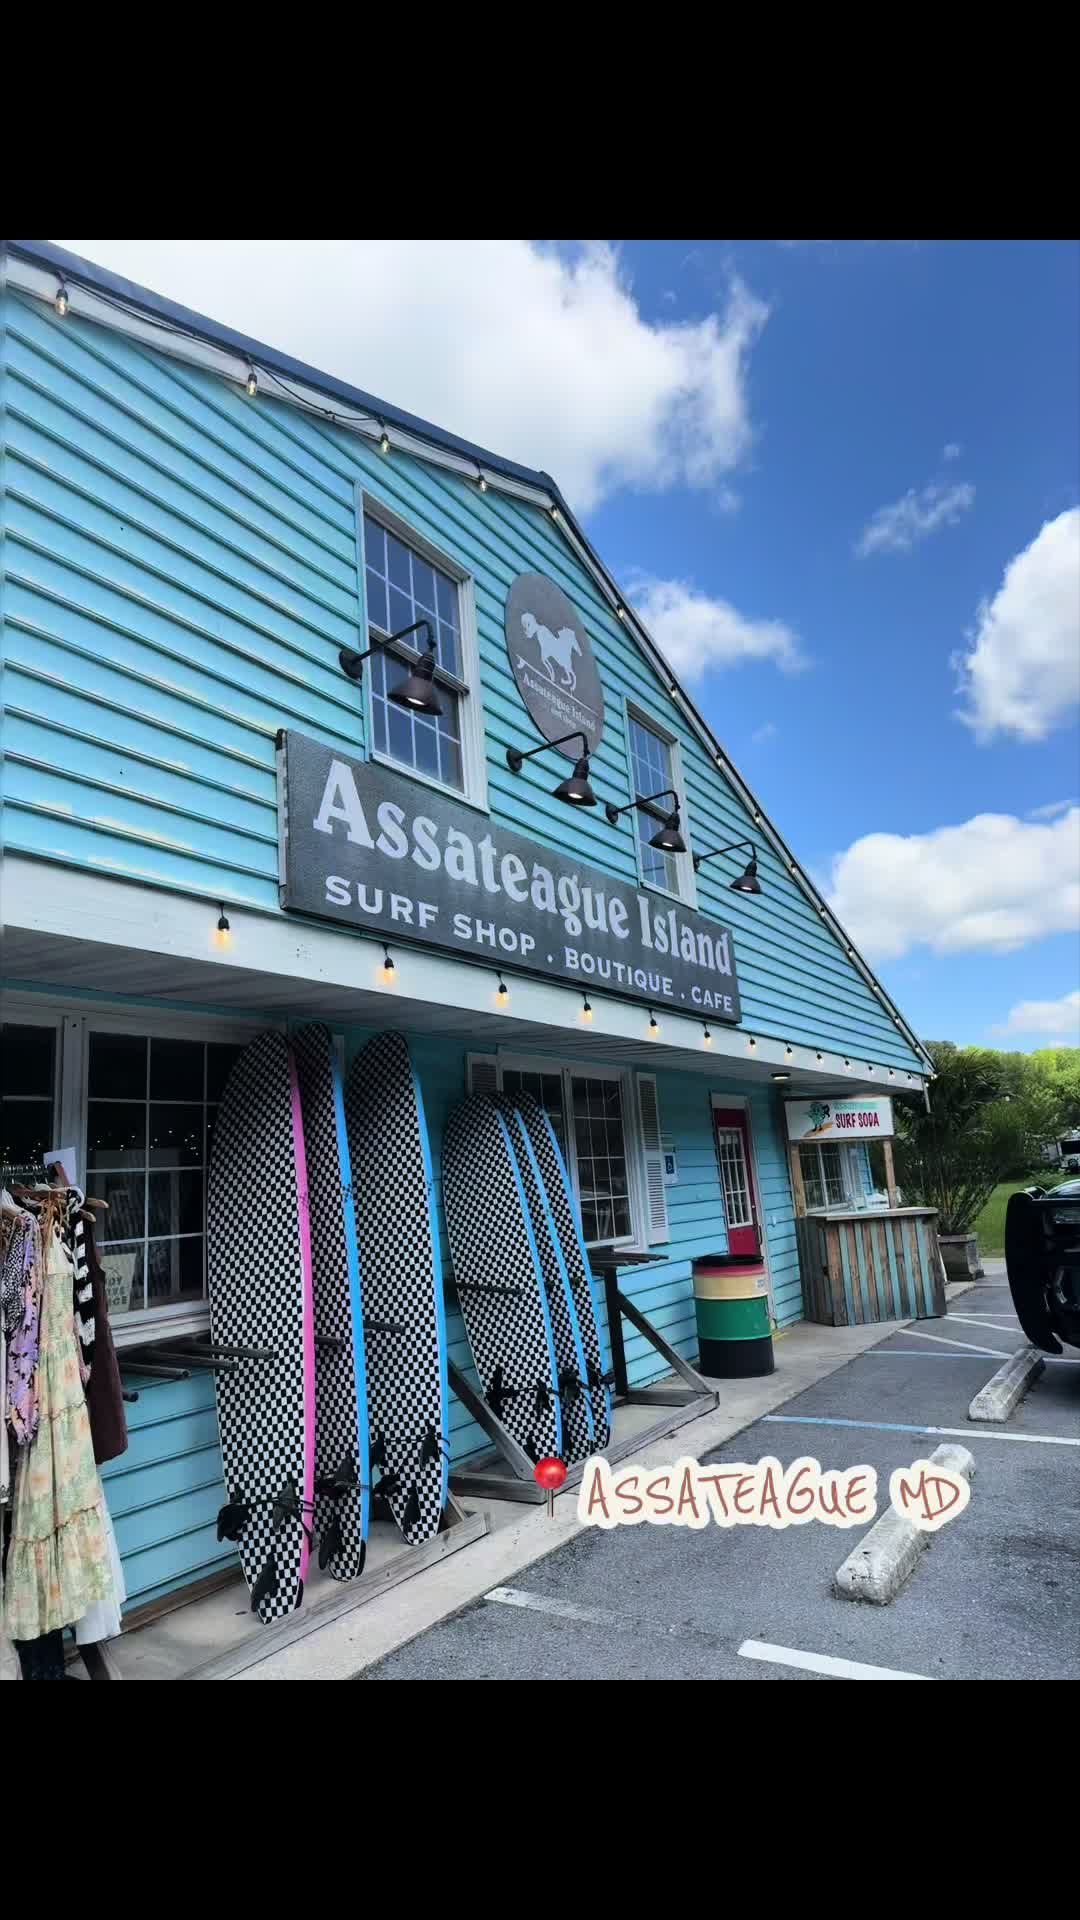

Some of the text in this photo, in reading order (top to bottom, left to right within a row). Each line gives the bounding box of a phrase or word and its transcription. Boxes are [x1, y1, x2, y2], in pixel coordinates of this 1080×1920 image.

[312, 759, 733, 977] Assateague Island
[325, 875, 440, 929] SURF
[453, 913, 536, 956] SHOP
[564, 945, 674, 997] BOUTIQUE
[691, 985, 734, 1013] CAFE
[835, 1111, 880, 1129] SURF SODA
